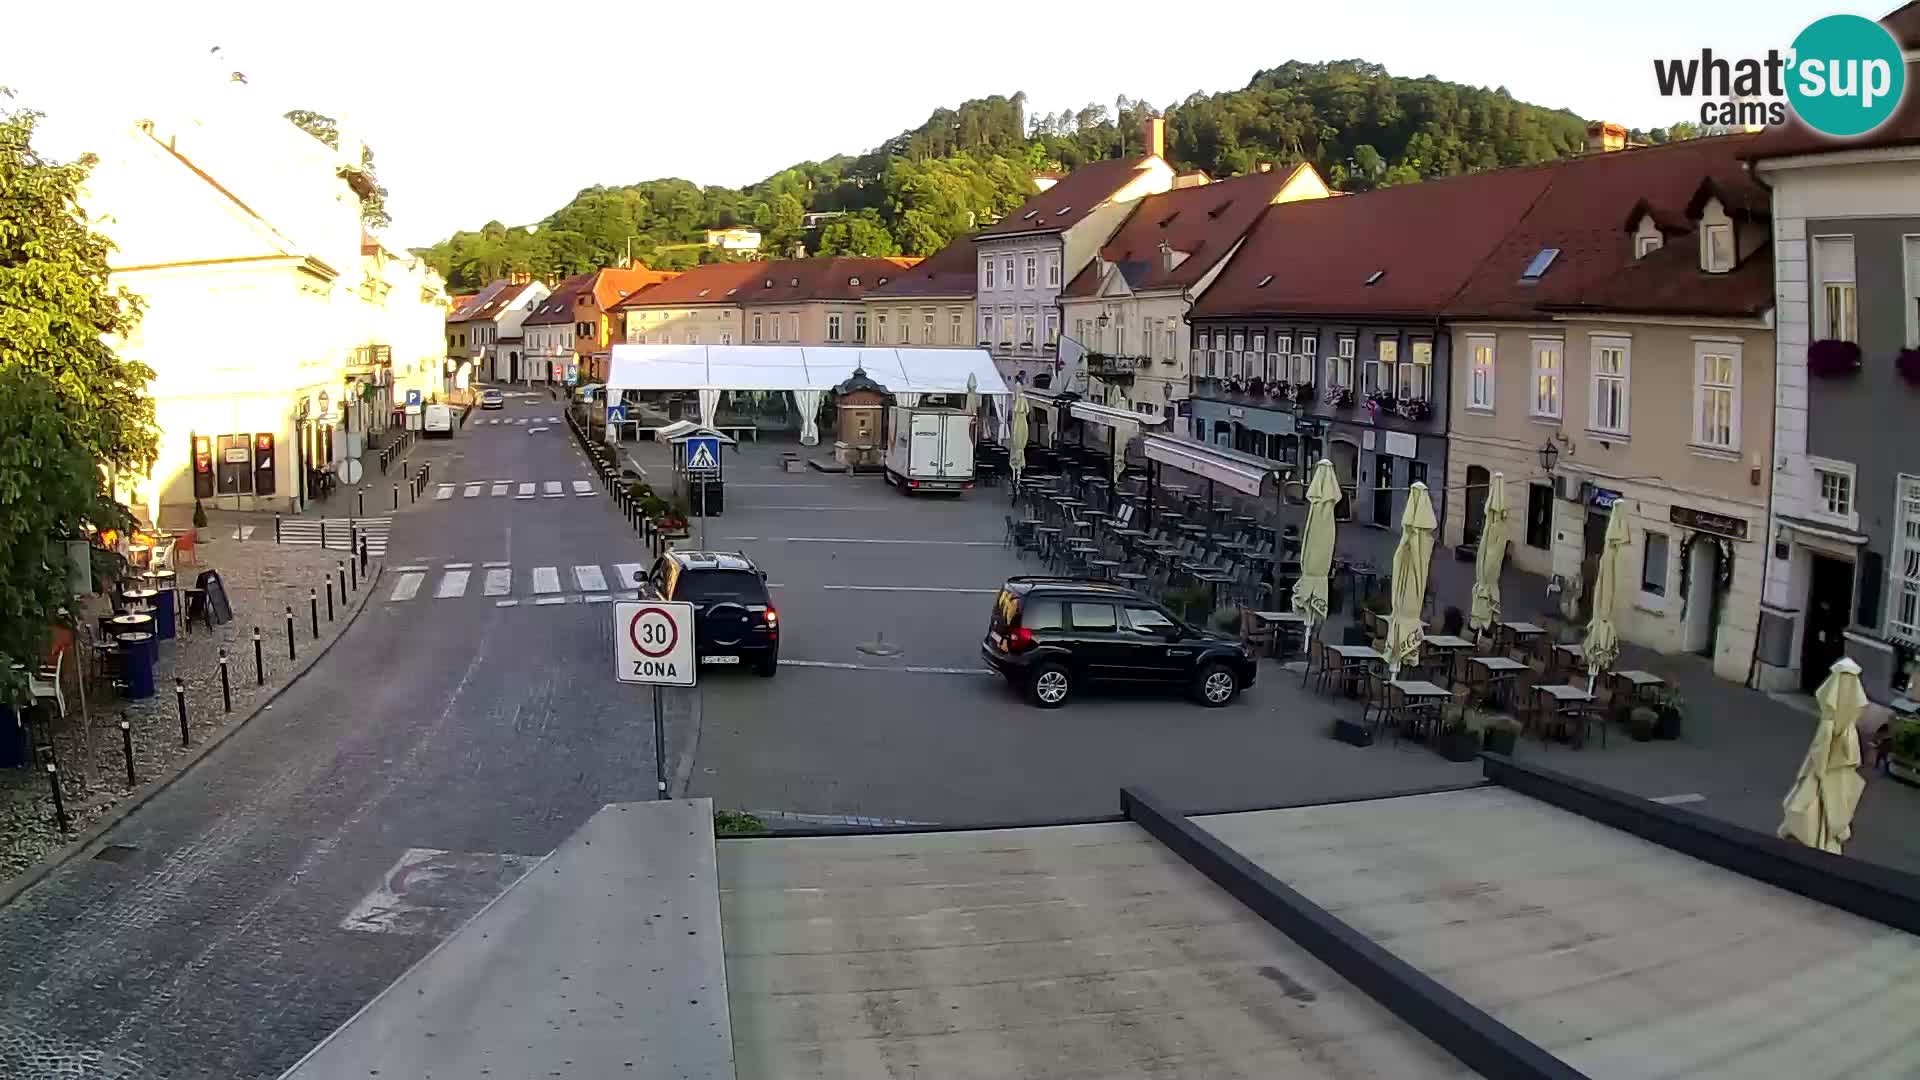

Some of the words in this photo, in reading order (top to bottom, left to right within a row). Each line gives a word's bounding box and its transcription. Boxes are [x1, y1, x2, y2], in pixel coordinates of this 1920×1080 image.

[409, 392, 417, 404] P
[642, 623, 667, 645] 30
[633, 660, 678, 678] ZONA
